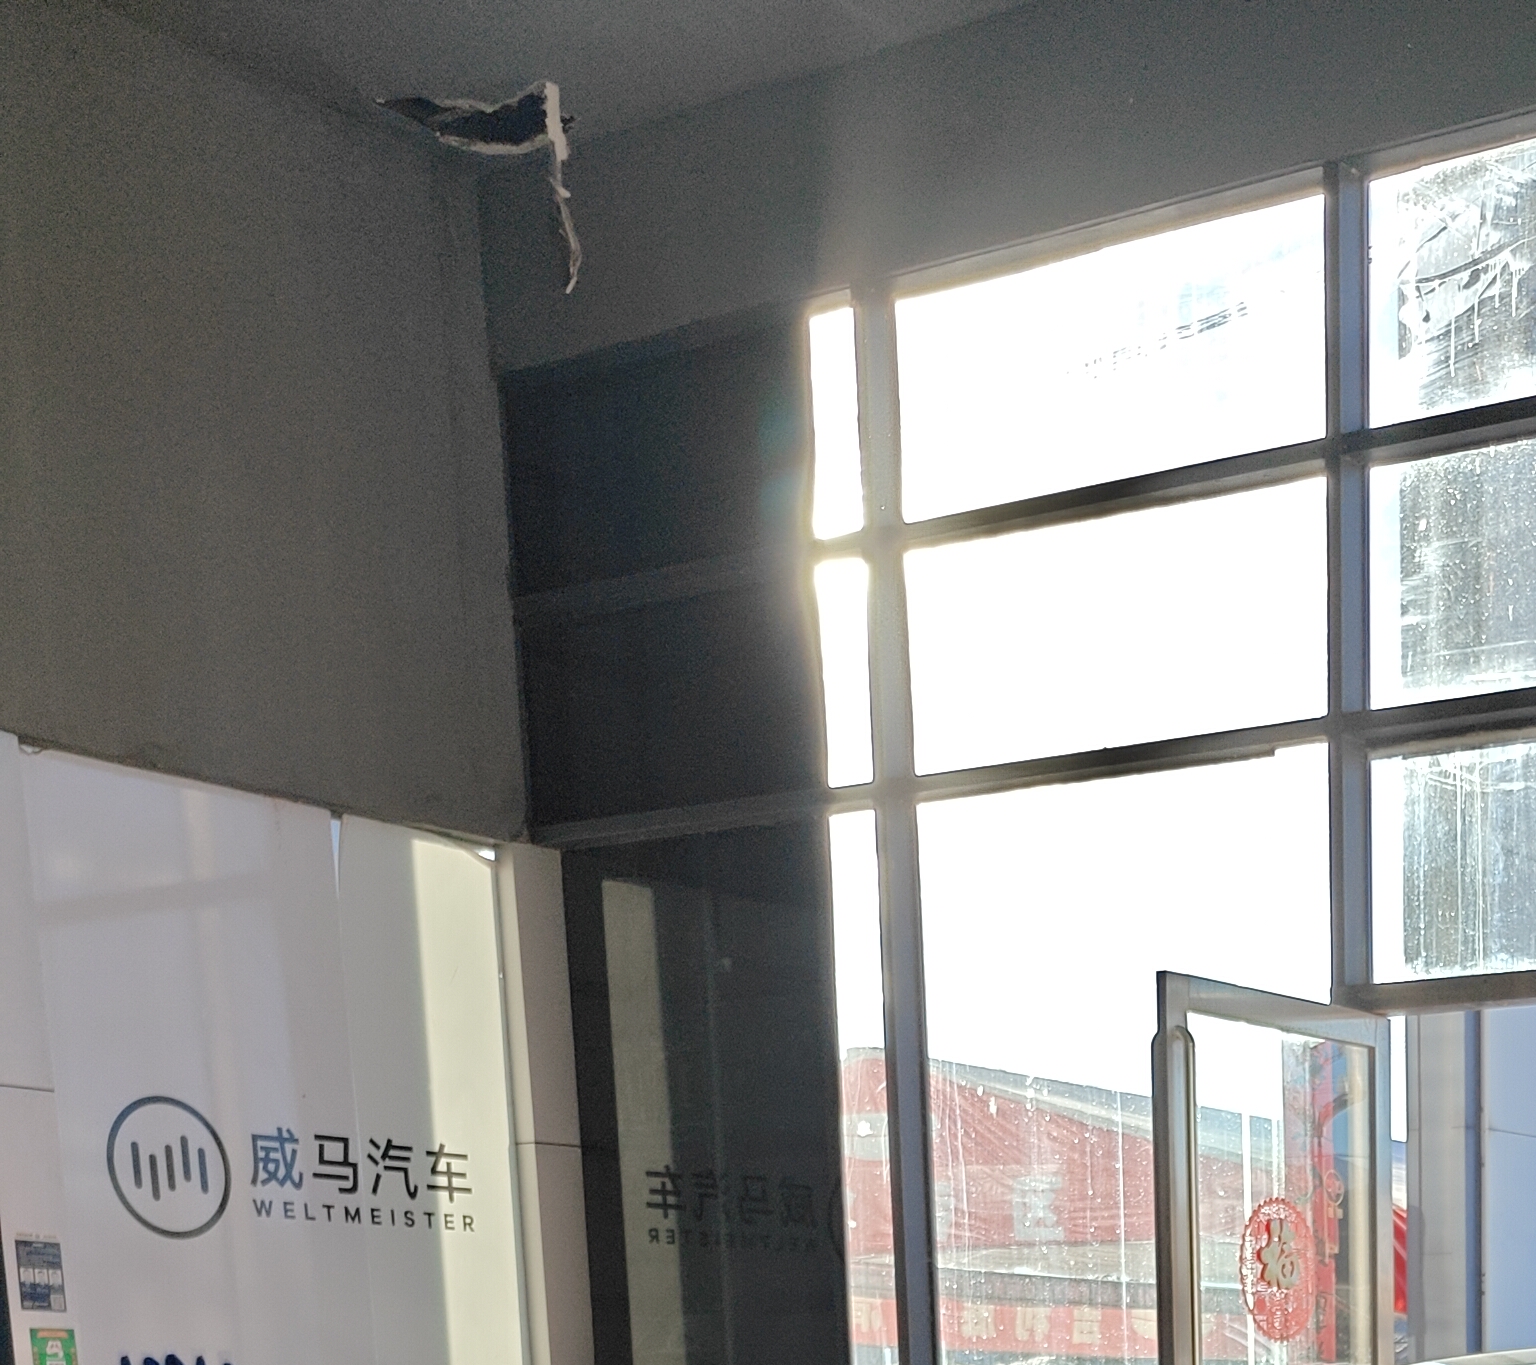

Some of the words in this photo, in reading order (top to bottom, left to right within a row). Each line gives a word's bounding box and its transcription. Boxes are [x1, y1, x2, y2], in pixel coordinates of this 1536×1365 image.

[249, 1126, 474, 1204] 威马汽车
[251, 1198, 476, 1233] WELTMEISTER
